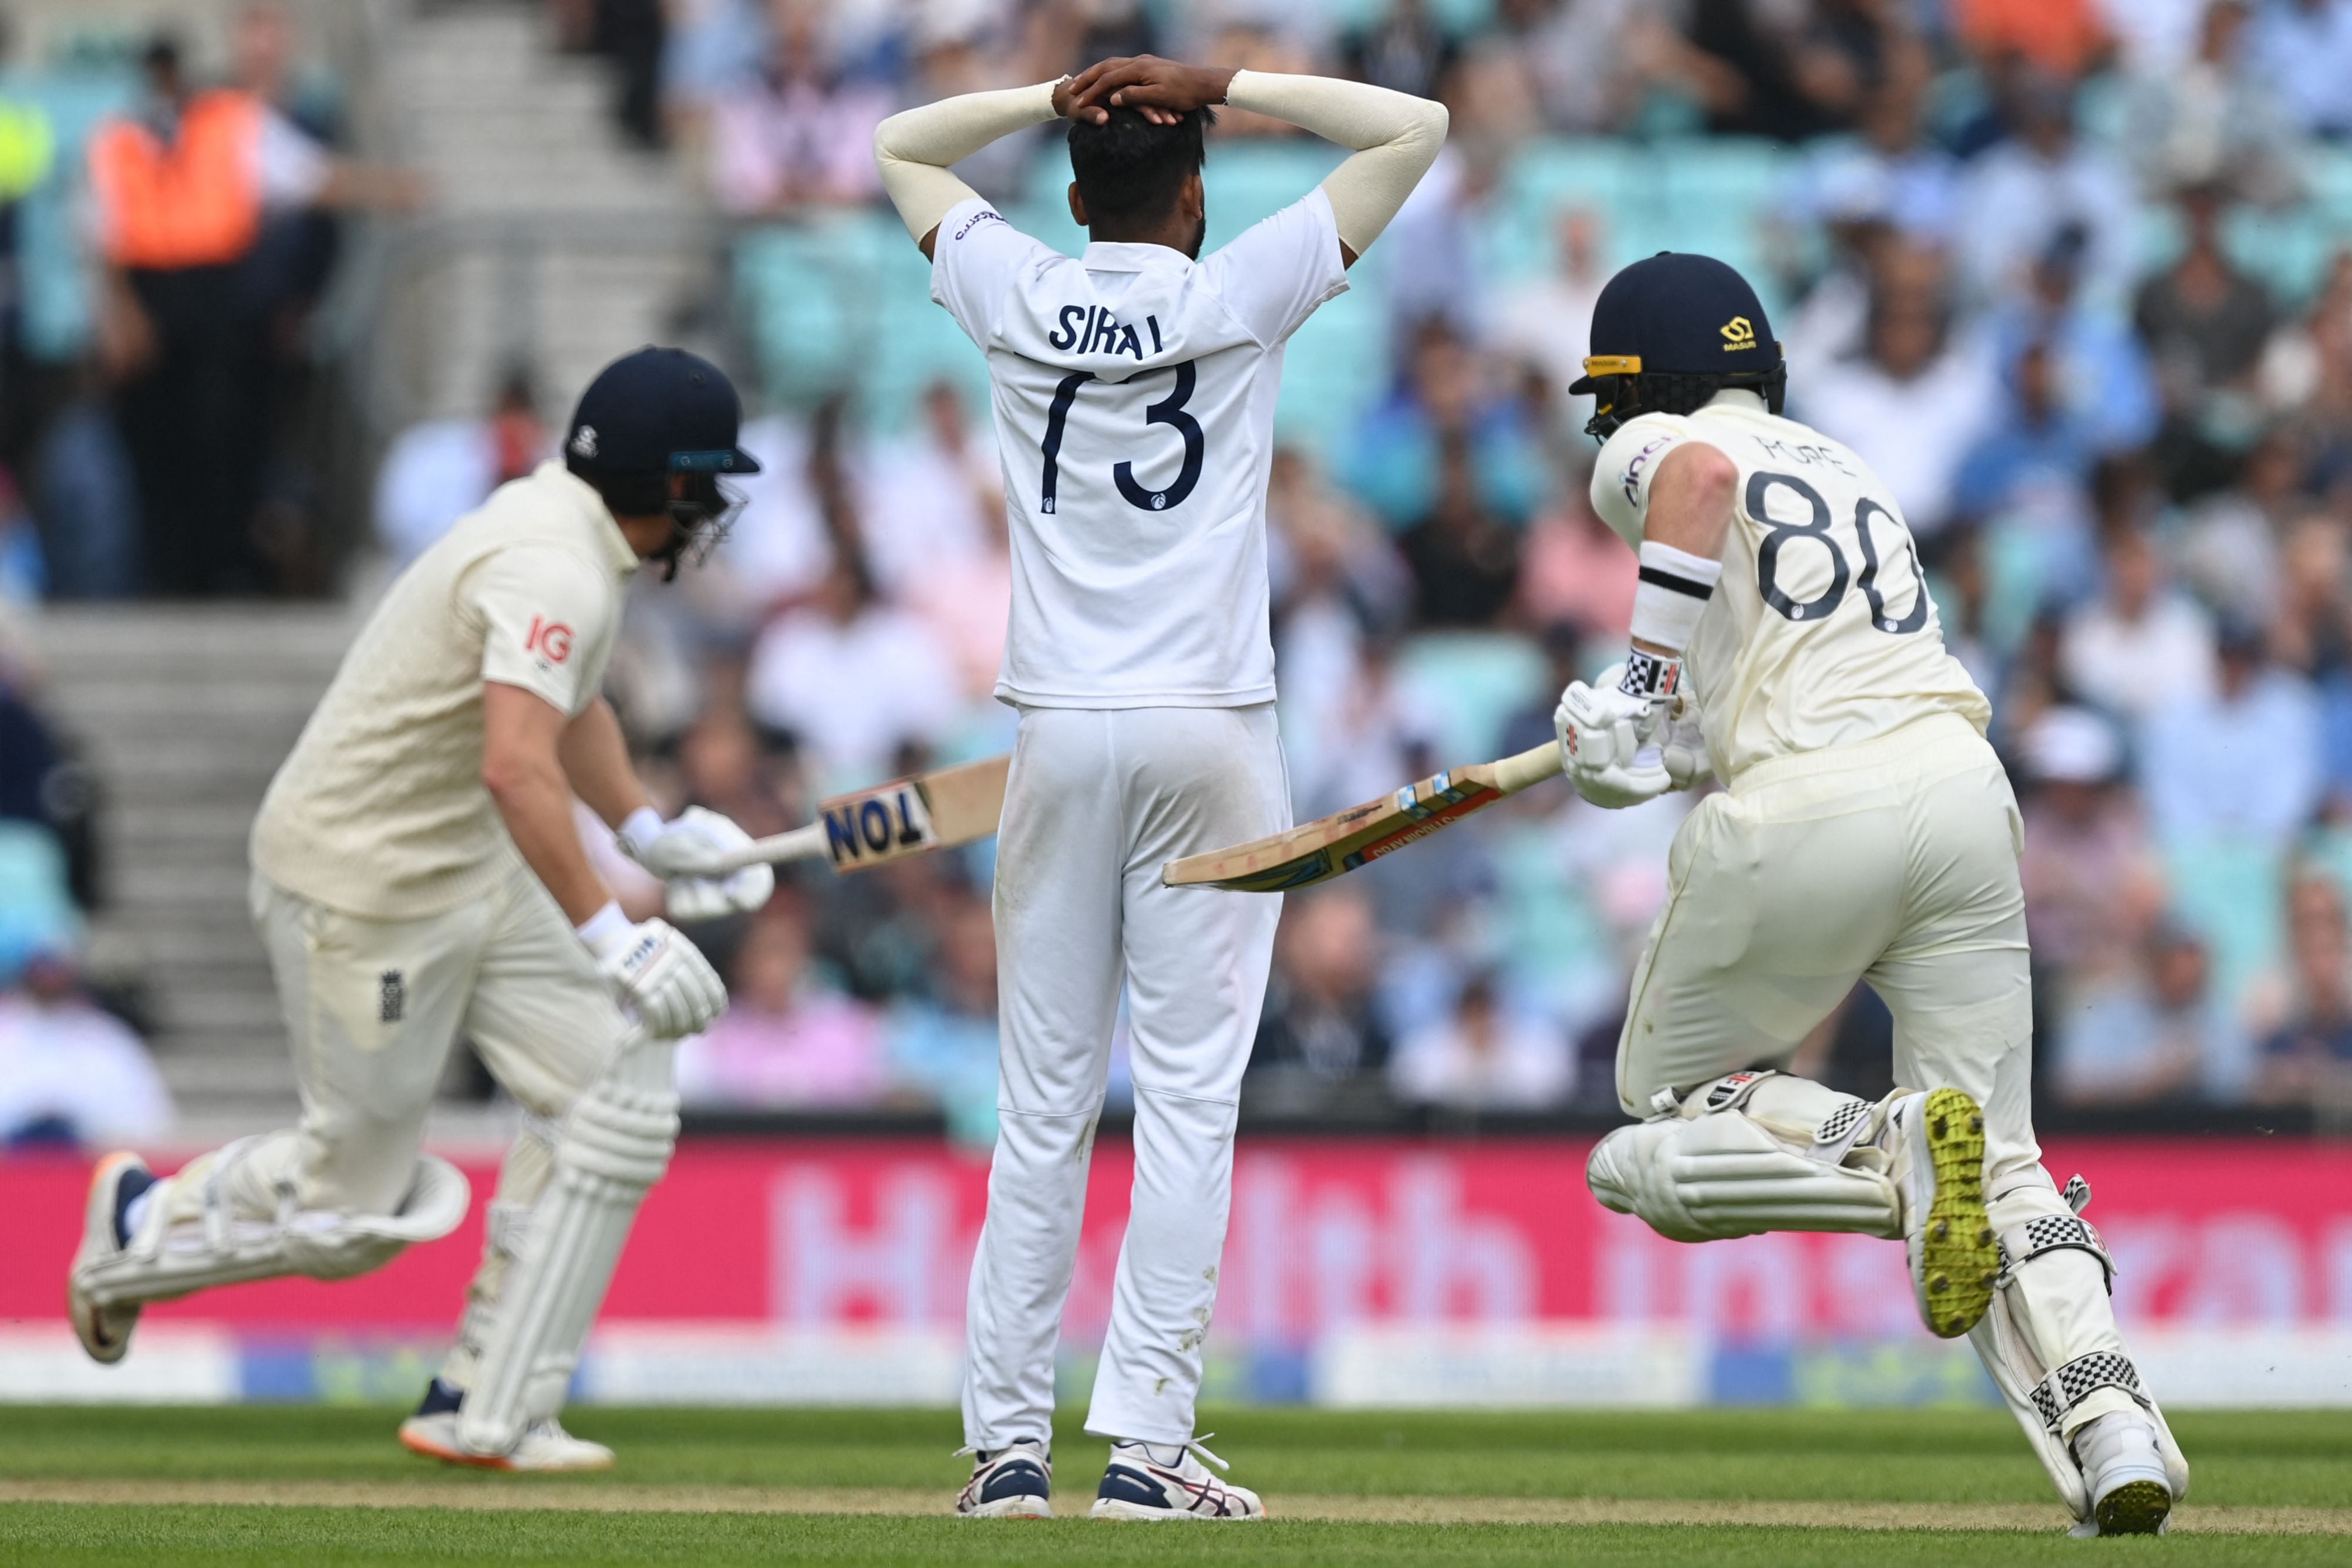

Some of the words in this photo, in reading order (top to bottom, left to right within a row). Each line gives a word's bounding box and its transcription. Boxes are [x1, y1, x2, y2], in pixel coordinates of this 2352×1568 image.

[1724, 340, 1757, 352] MASURI
[1619, 437, 1672, 508] cinc
[1752, 436, 1857, 477] POPE
[1746, 470, 1928, 635] 80
[525, 615, 575, 664] IG
